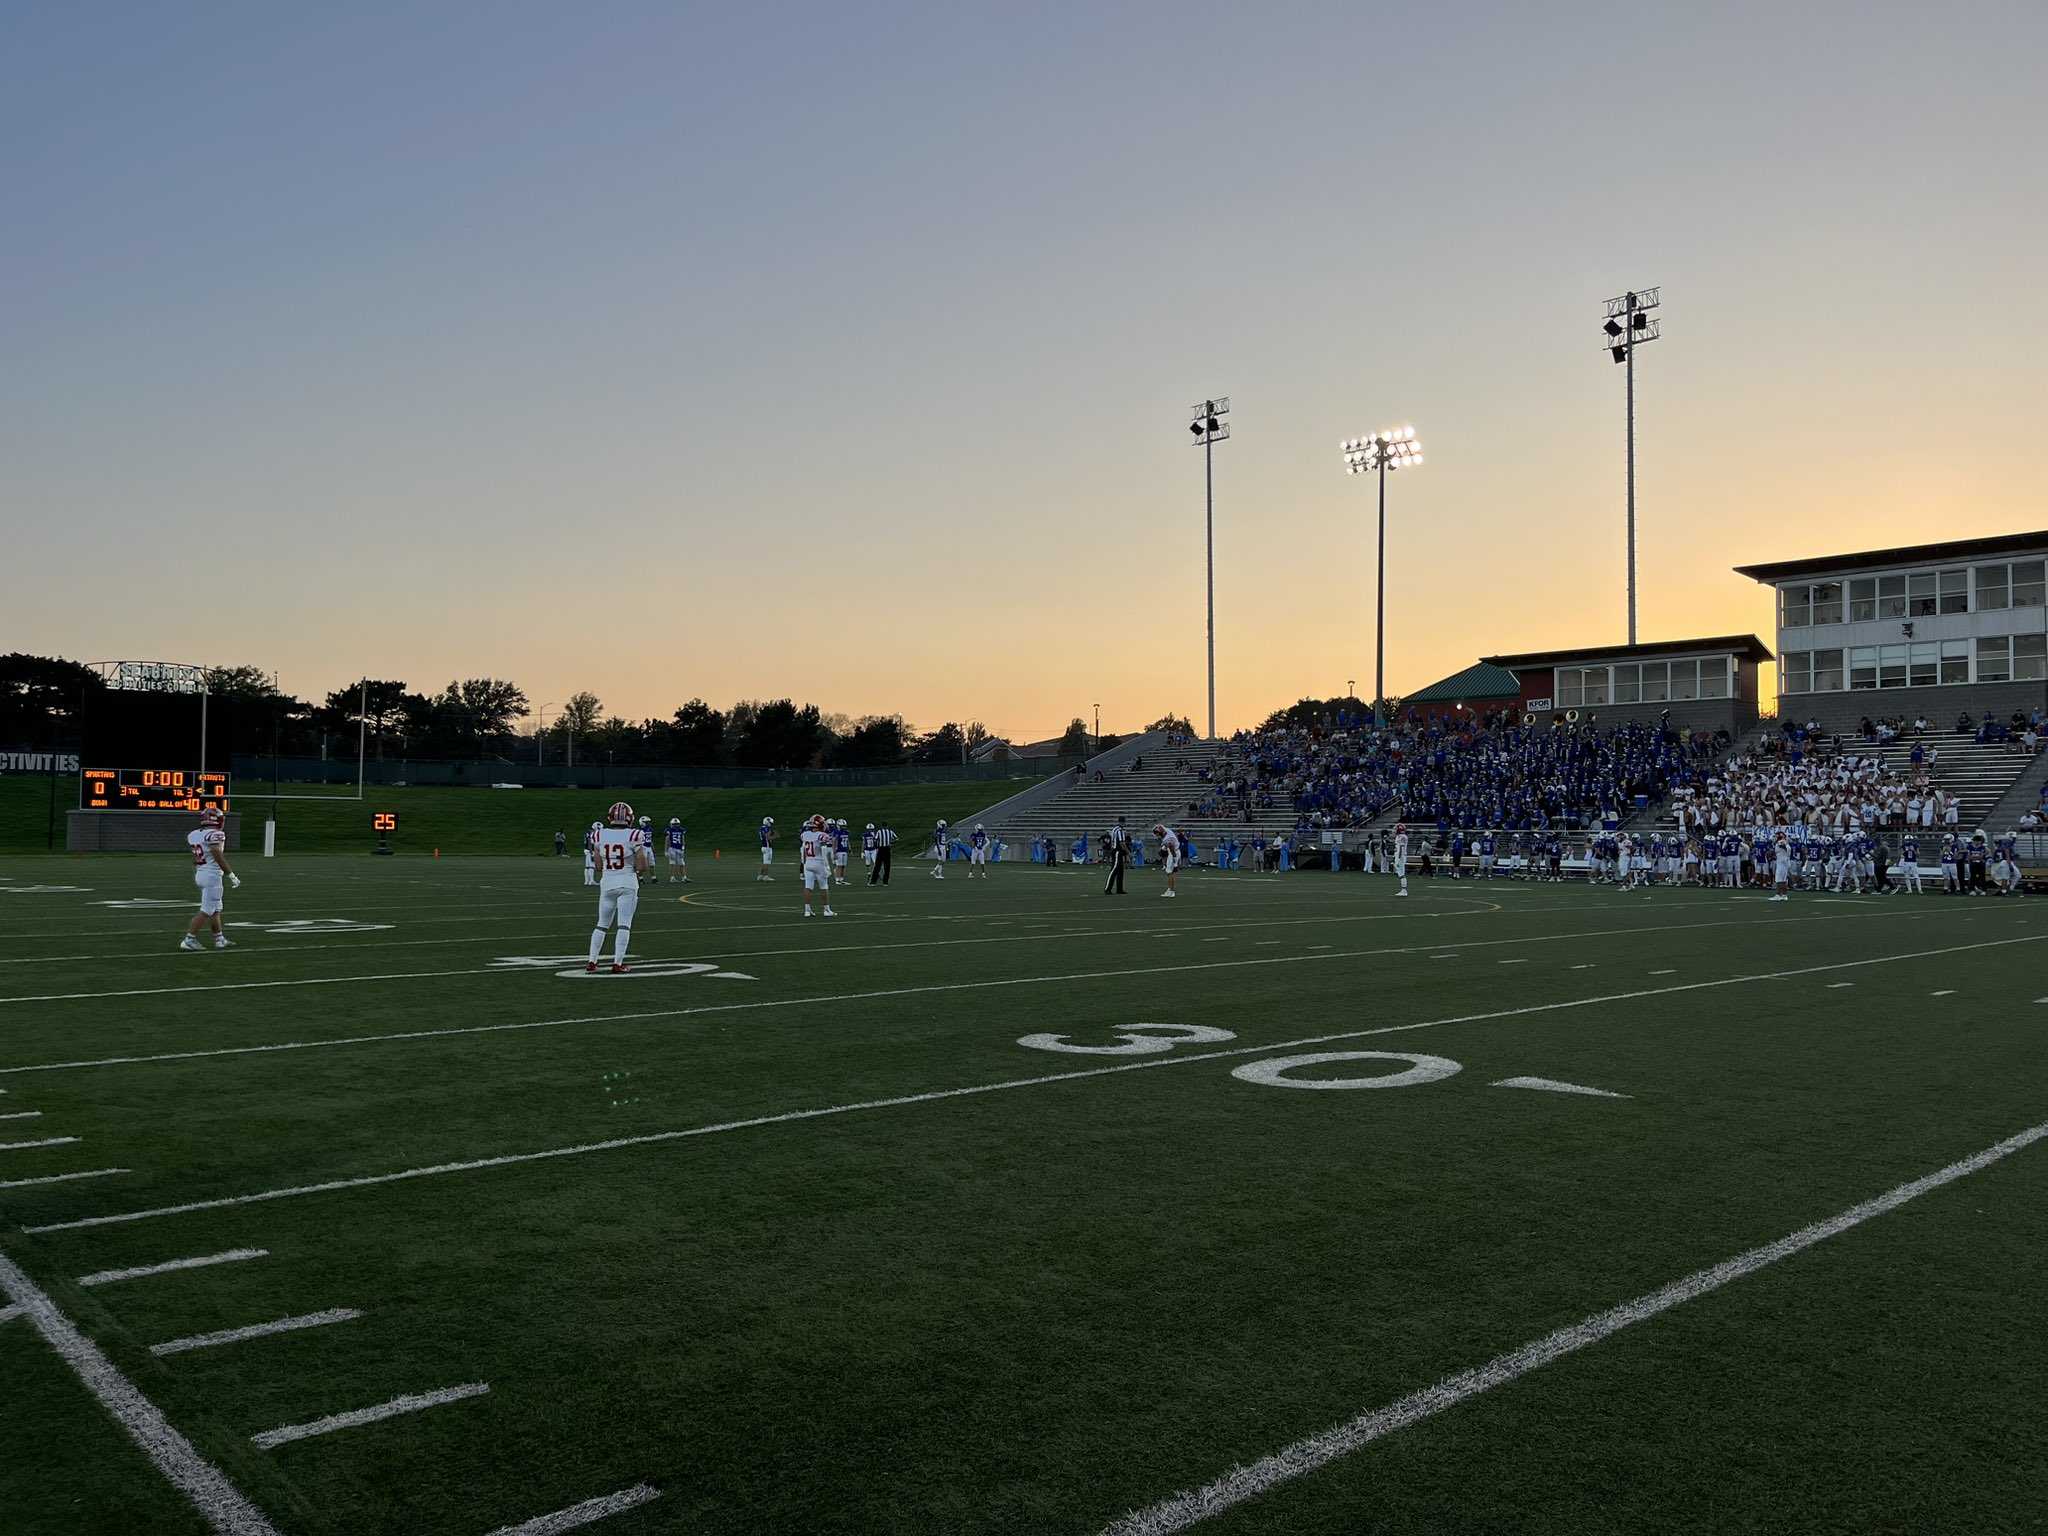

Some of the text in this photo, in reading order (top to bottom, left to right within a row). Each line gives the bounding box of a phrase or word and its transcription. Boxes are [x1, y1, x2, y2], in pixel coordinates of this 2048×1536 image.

[143, 771, 183, 786] 0:00
[95, 782, 104, 794] 0
[215, 785, 224, 796] 0
[183, 798, 199, 811] 40
[223, 799, 228, 811] 1
[374, 814, 395, 830] 25
[603, 844, 623, 870] 13
[804, 841, 816, 858] 21
[1018, 1021, 1464, 1090] 30
